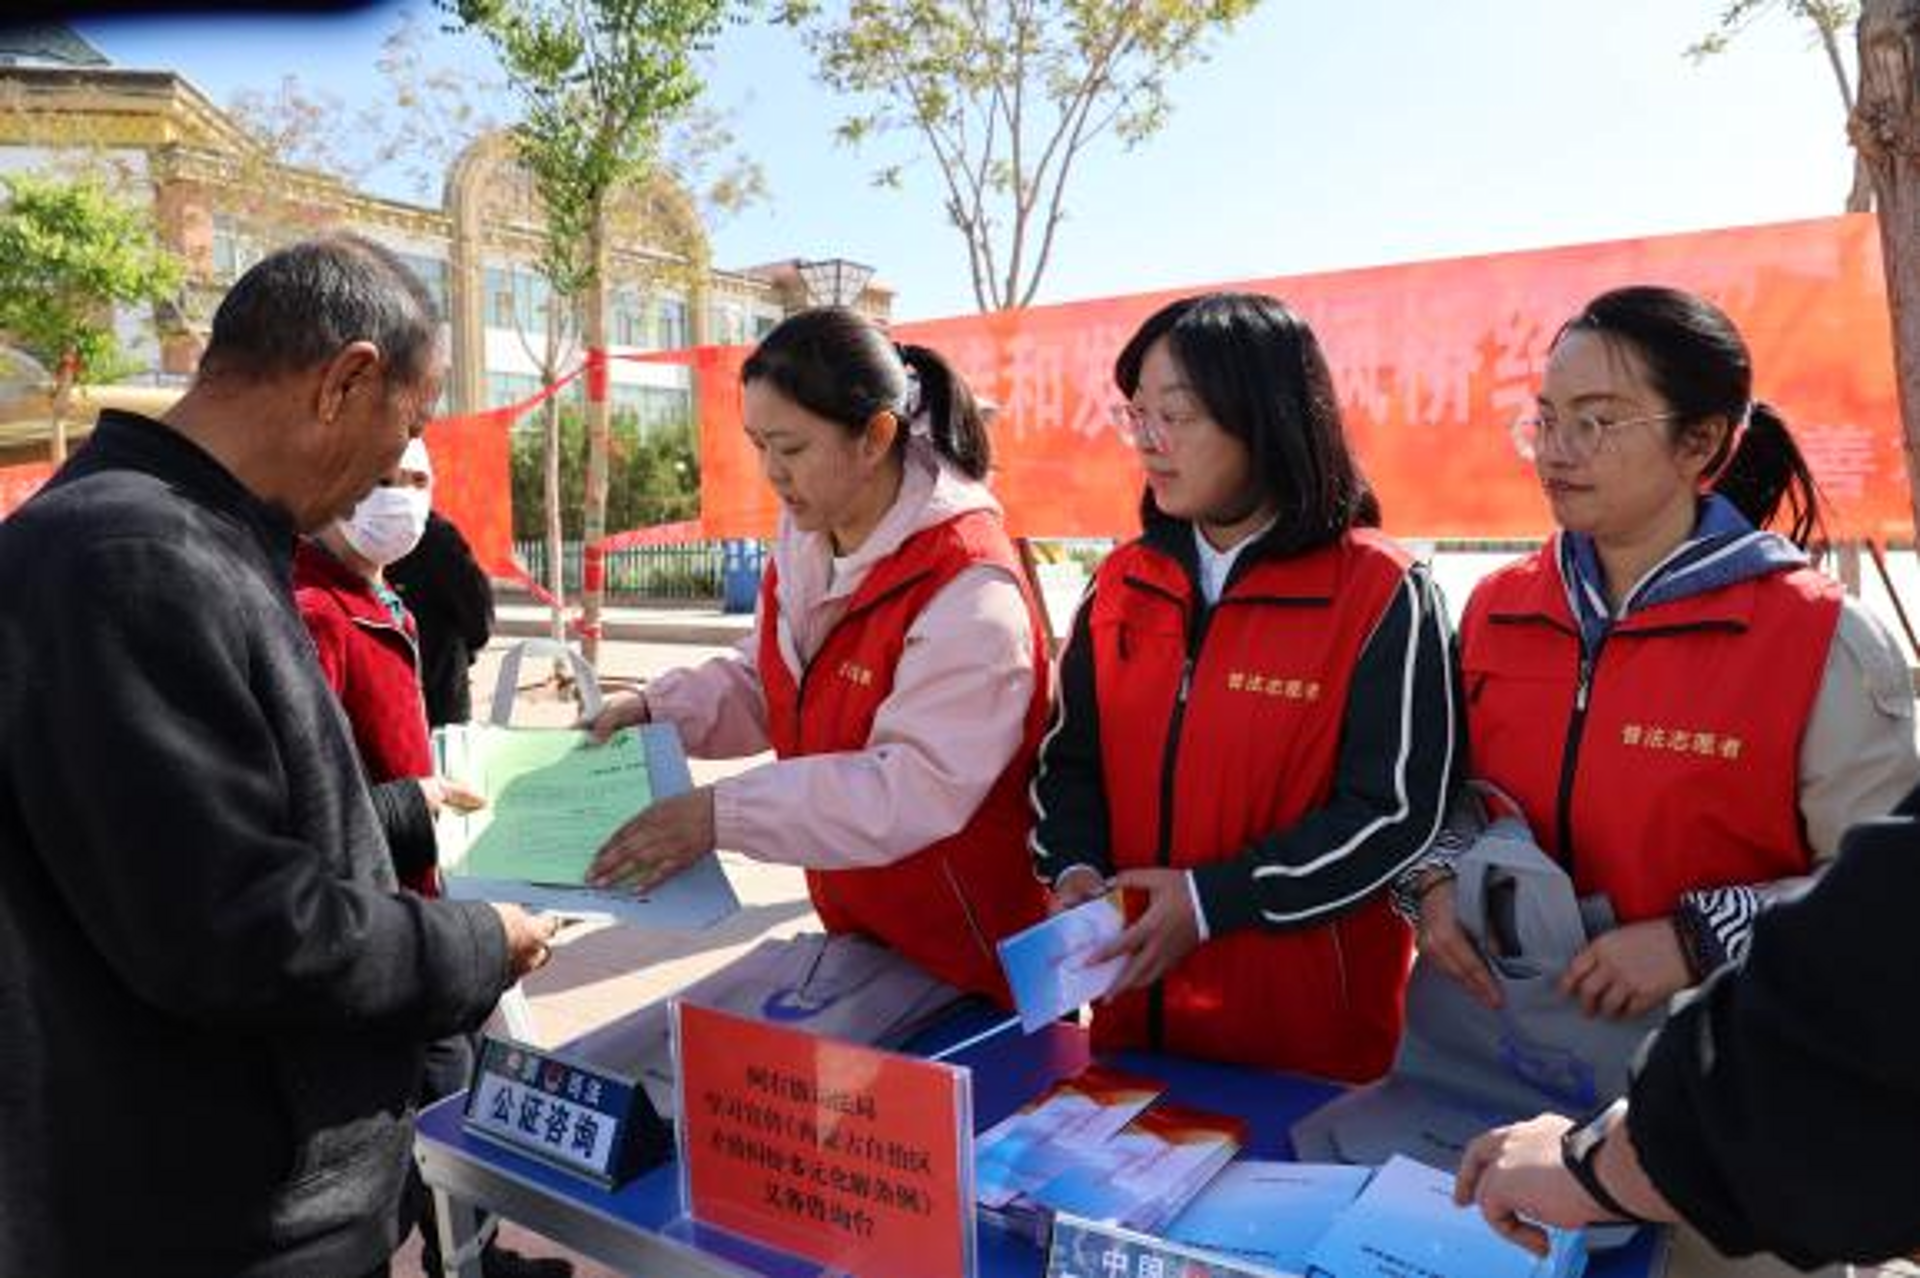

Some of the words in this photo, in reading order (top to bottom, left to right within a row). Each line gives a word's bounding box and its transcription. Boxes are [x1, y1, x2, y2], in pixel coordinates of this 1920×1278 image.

[1622, 724, 1742, 760] 普法志愿者
[492, 1085, 600, 1159] 公证咨询
